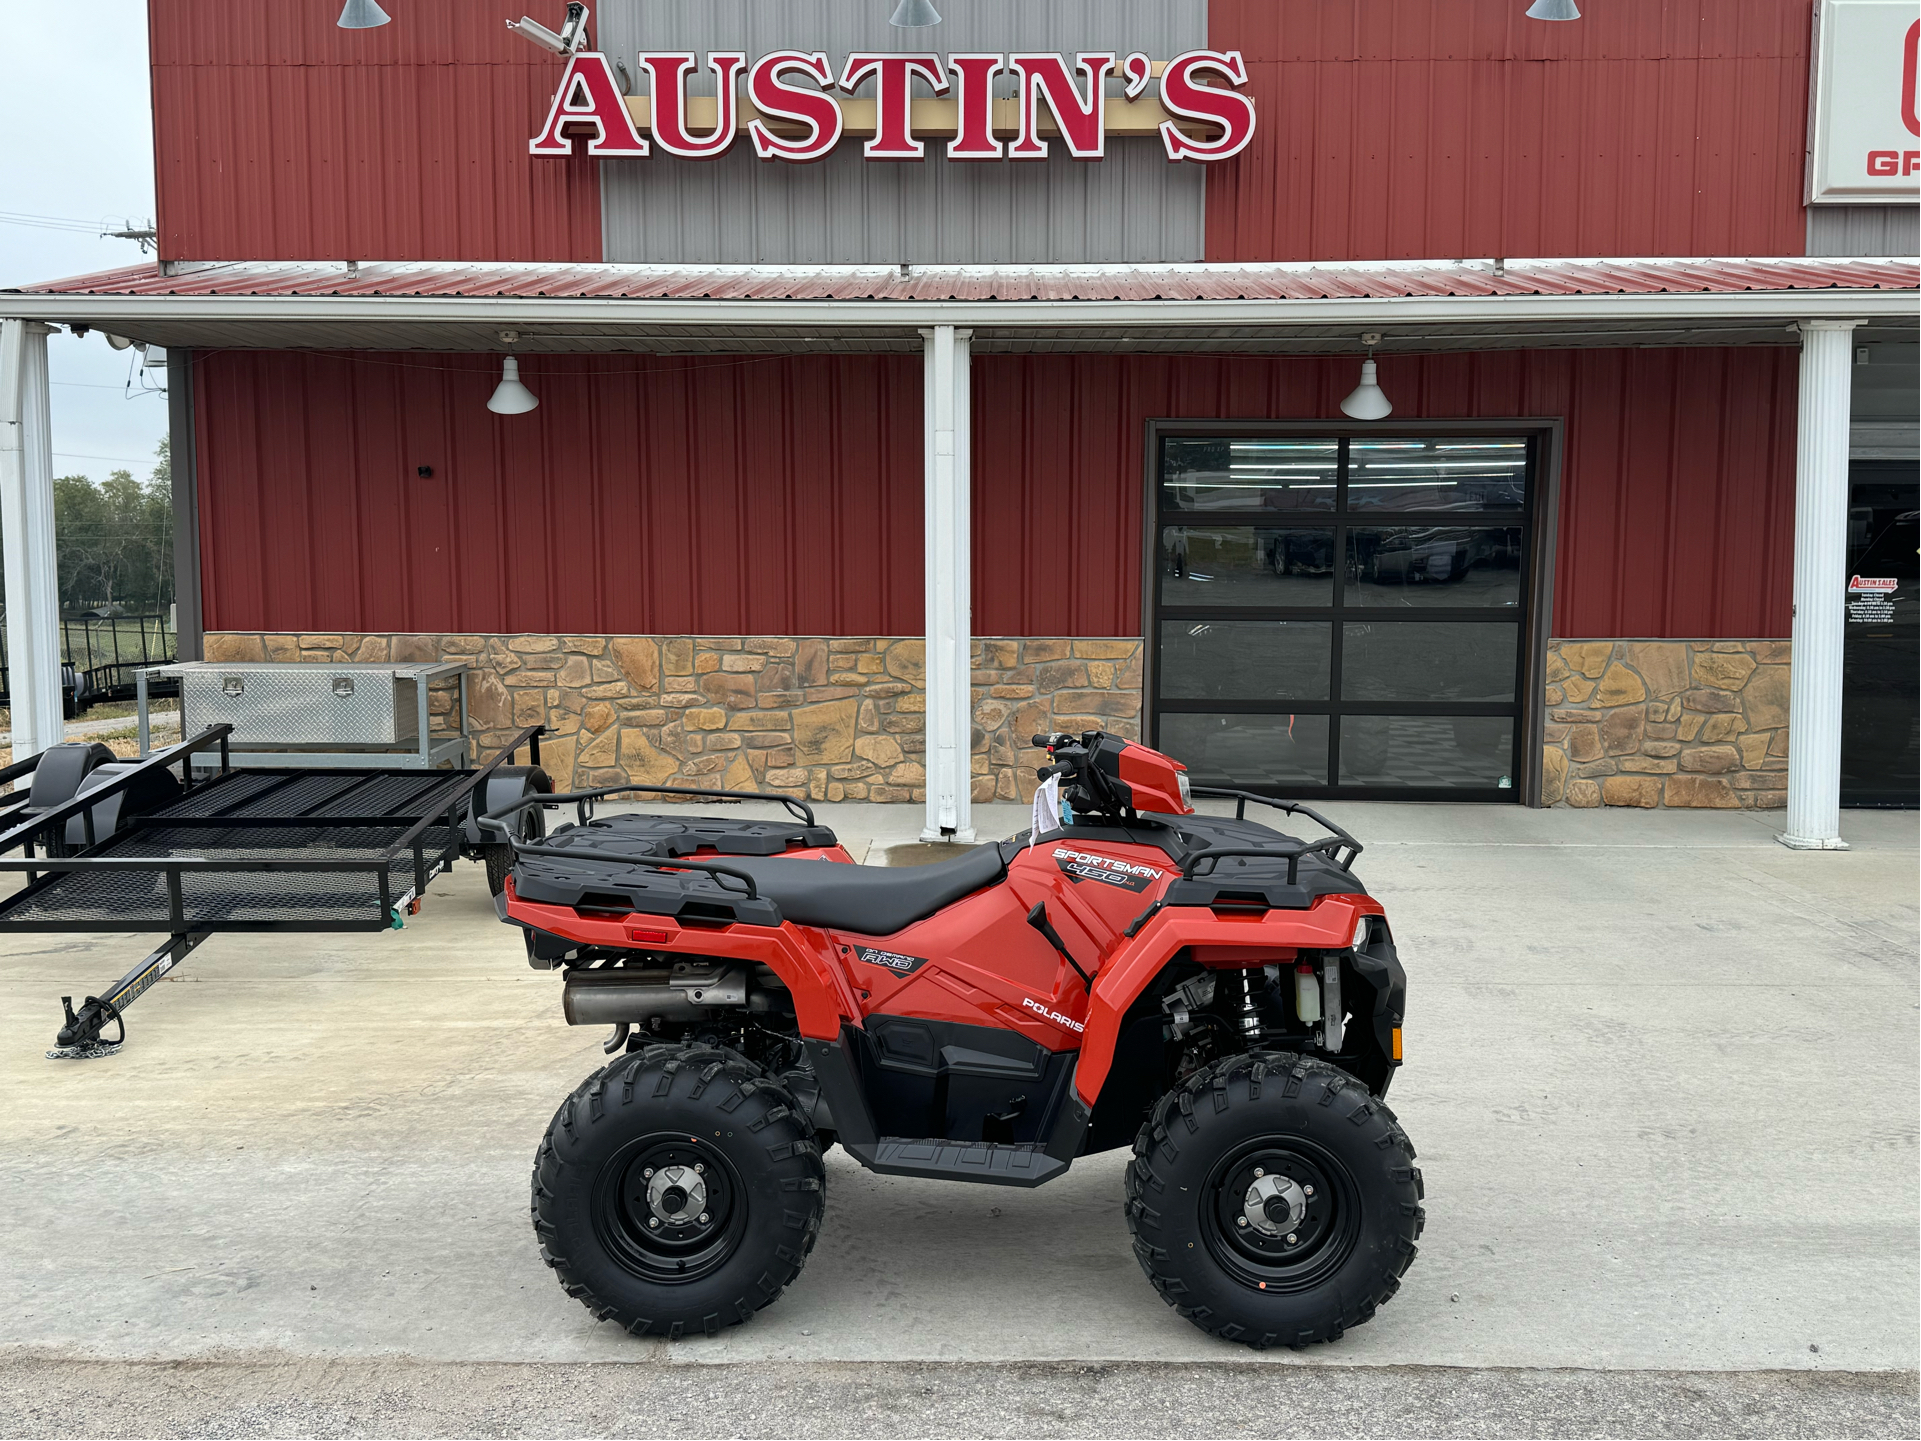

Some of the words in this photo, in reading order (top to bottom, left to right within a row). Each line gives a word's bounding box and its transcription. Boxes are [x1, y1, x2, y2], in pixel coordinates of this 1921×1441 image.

[529, 49, 1256, 161] AUSTIN'S
[1850, 576, 1876, 588] AUSTIN
[1051, 848, 1162, 880] SPORTSMAN
[1067, 863, 1127, 884] 450
[861, 952, 912, 970] AWD
[1022, 997, 1084, 1033] POLARIS
